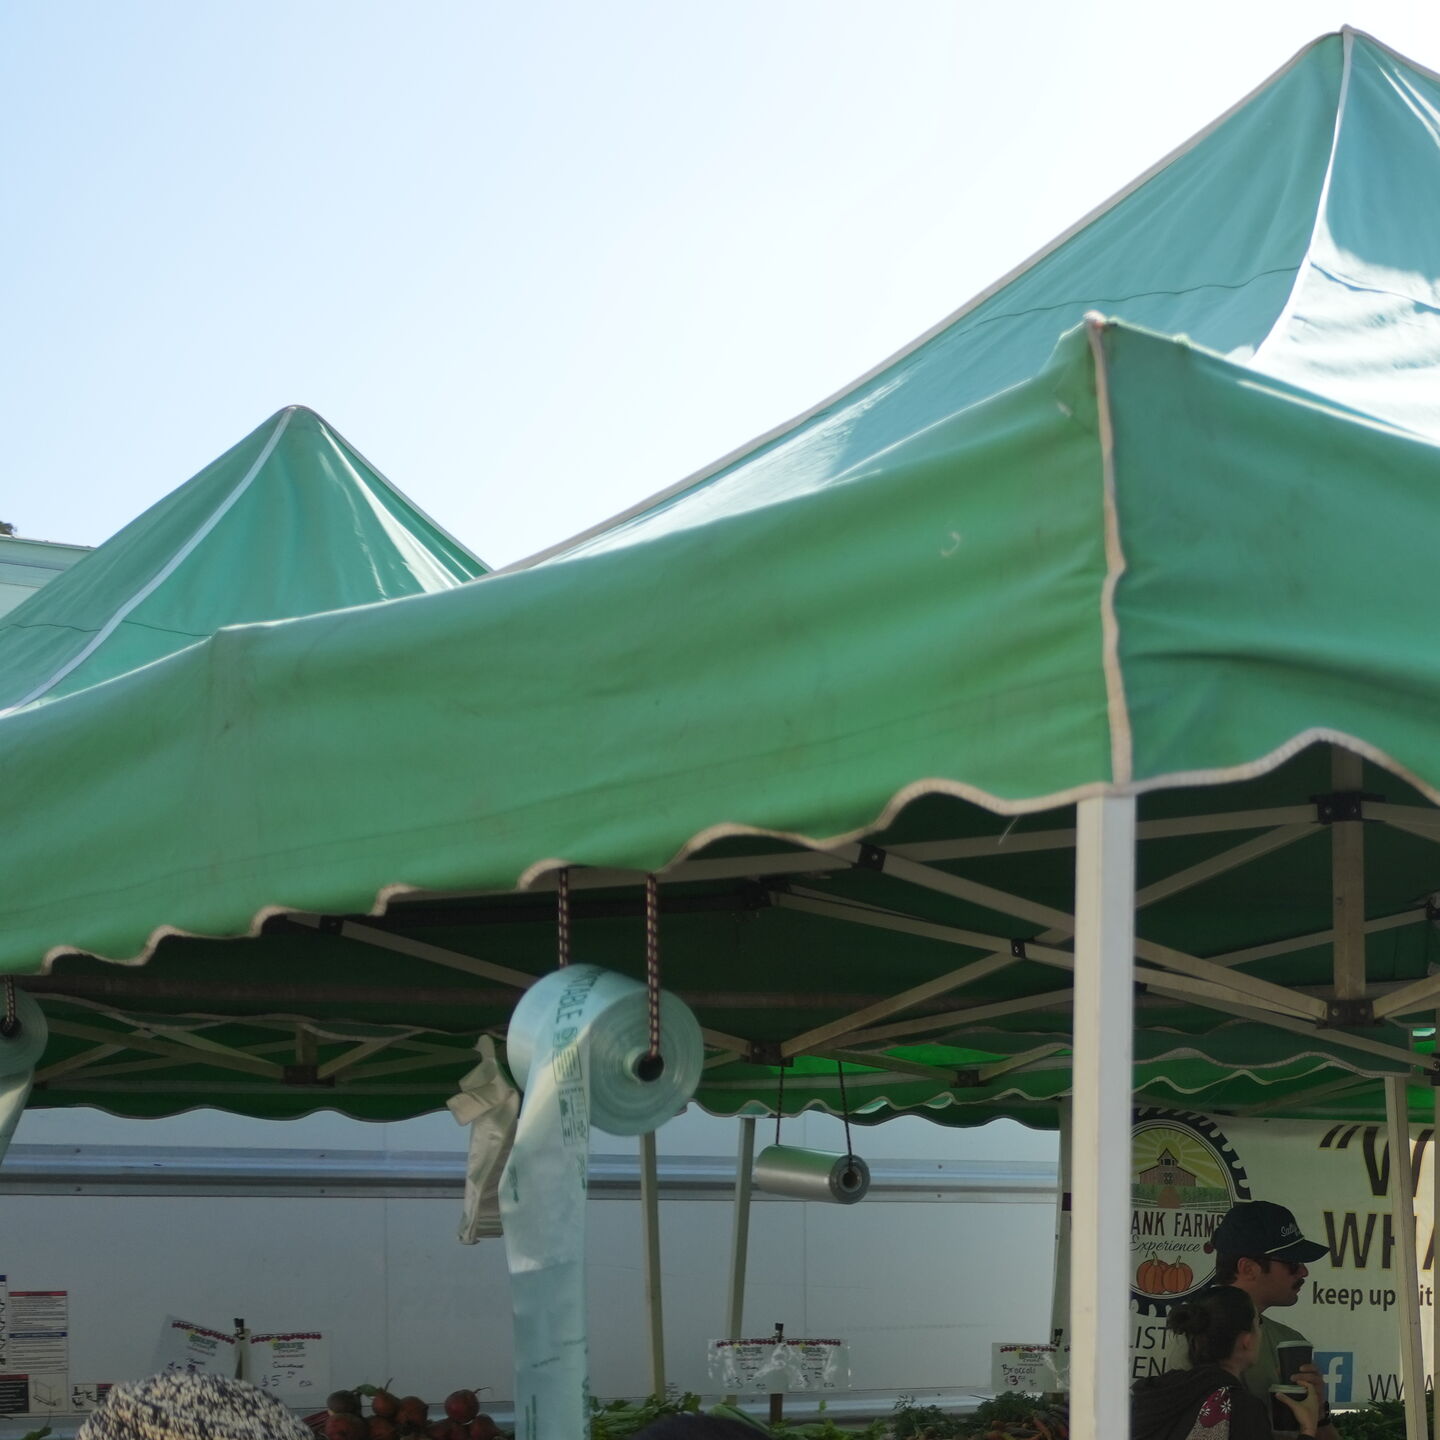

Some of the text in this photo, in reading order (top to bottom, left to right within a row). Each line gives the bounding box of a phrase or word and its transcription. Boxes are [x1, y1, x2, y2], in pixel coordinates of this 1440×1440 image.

[1130, 1210, 1167, 1237] ANK
[1130, 1234, 1201, 1258] Experience
[1312, 1281, 1363, 1312] keep
[1369, 1288, 1396, 1312] up
[1134, 1326, 1168, 1350] IST
